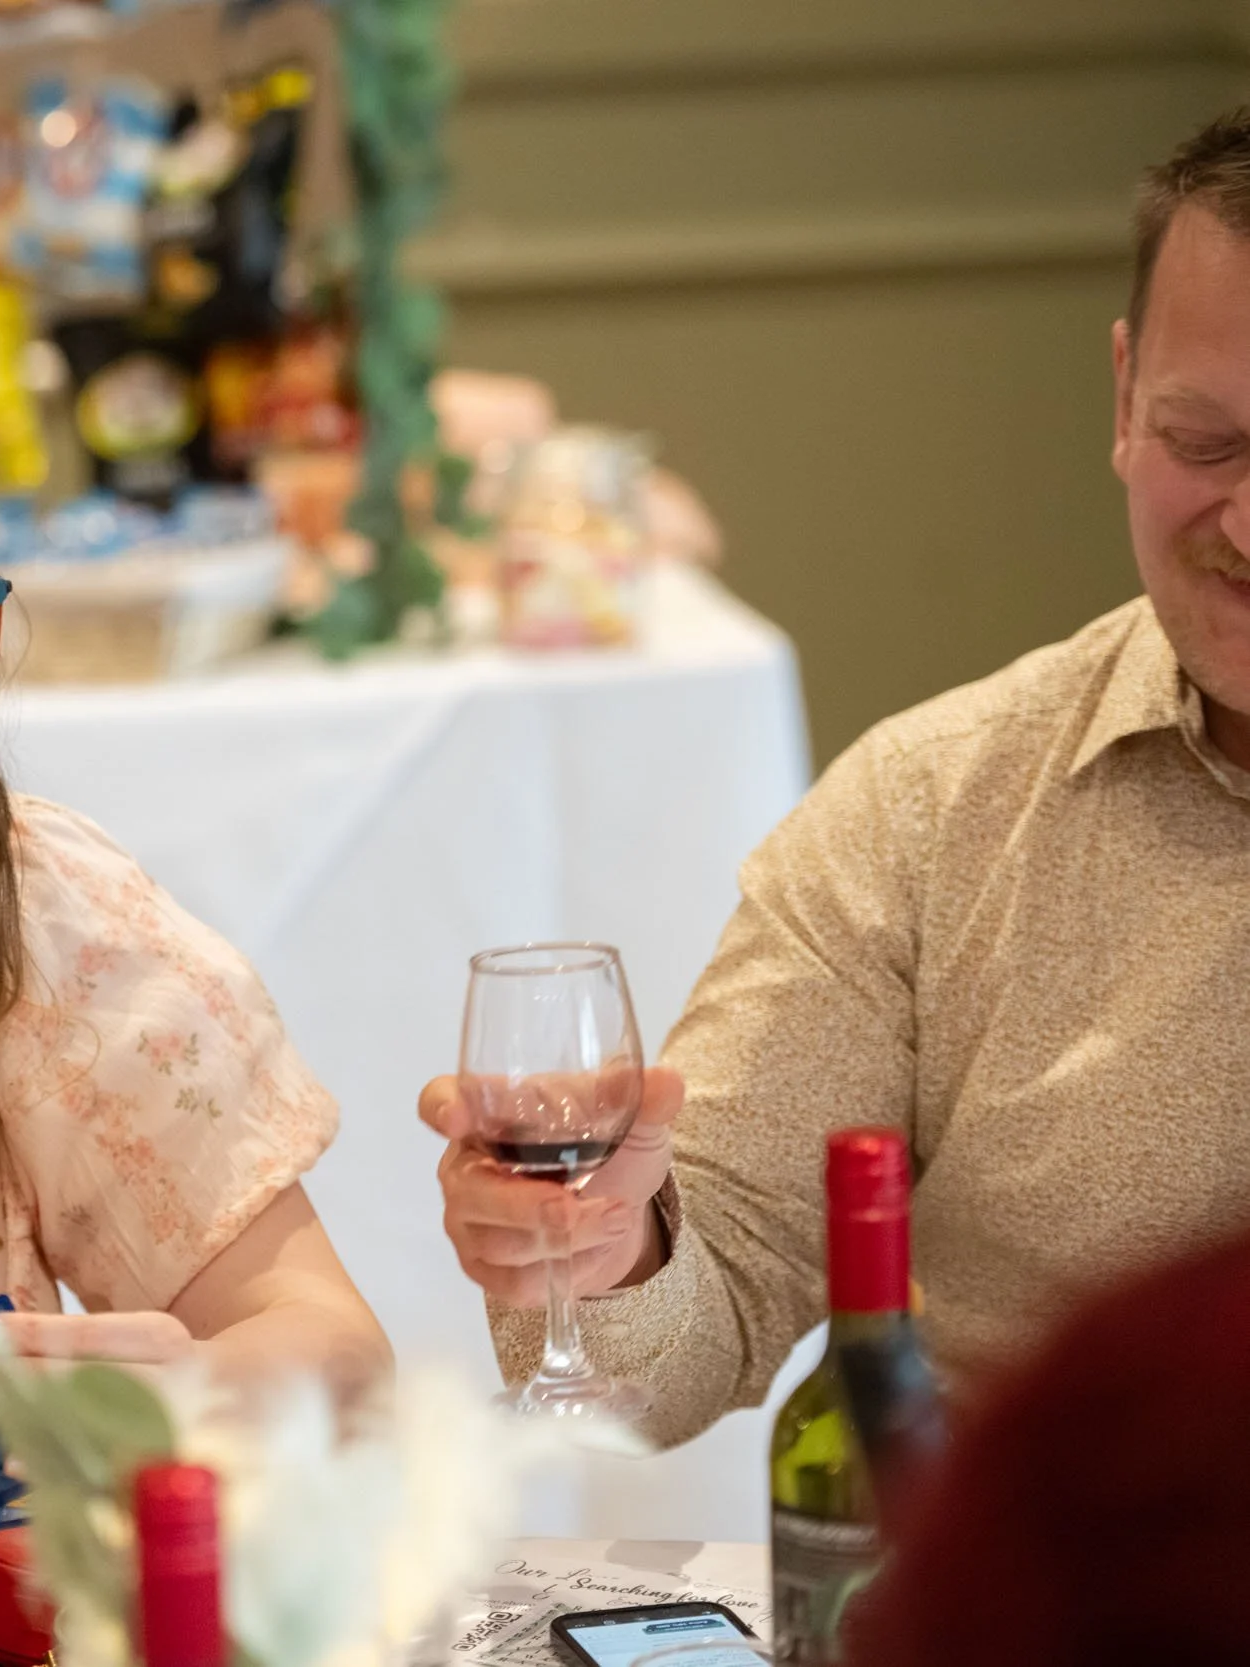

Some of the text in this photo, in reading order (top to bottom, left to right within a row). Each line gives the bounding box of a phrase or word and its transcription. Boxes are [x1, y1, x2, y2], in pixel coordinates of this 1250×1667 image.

[495, 1559, 548, 1578] Our
[569, 1577, 673, 1603] Searching
[677, 1592, 708, 1603] for
[716, 1593, 759, 1609] love
